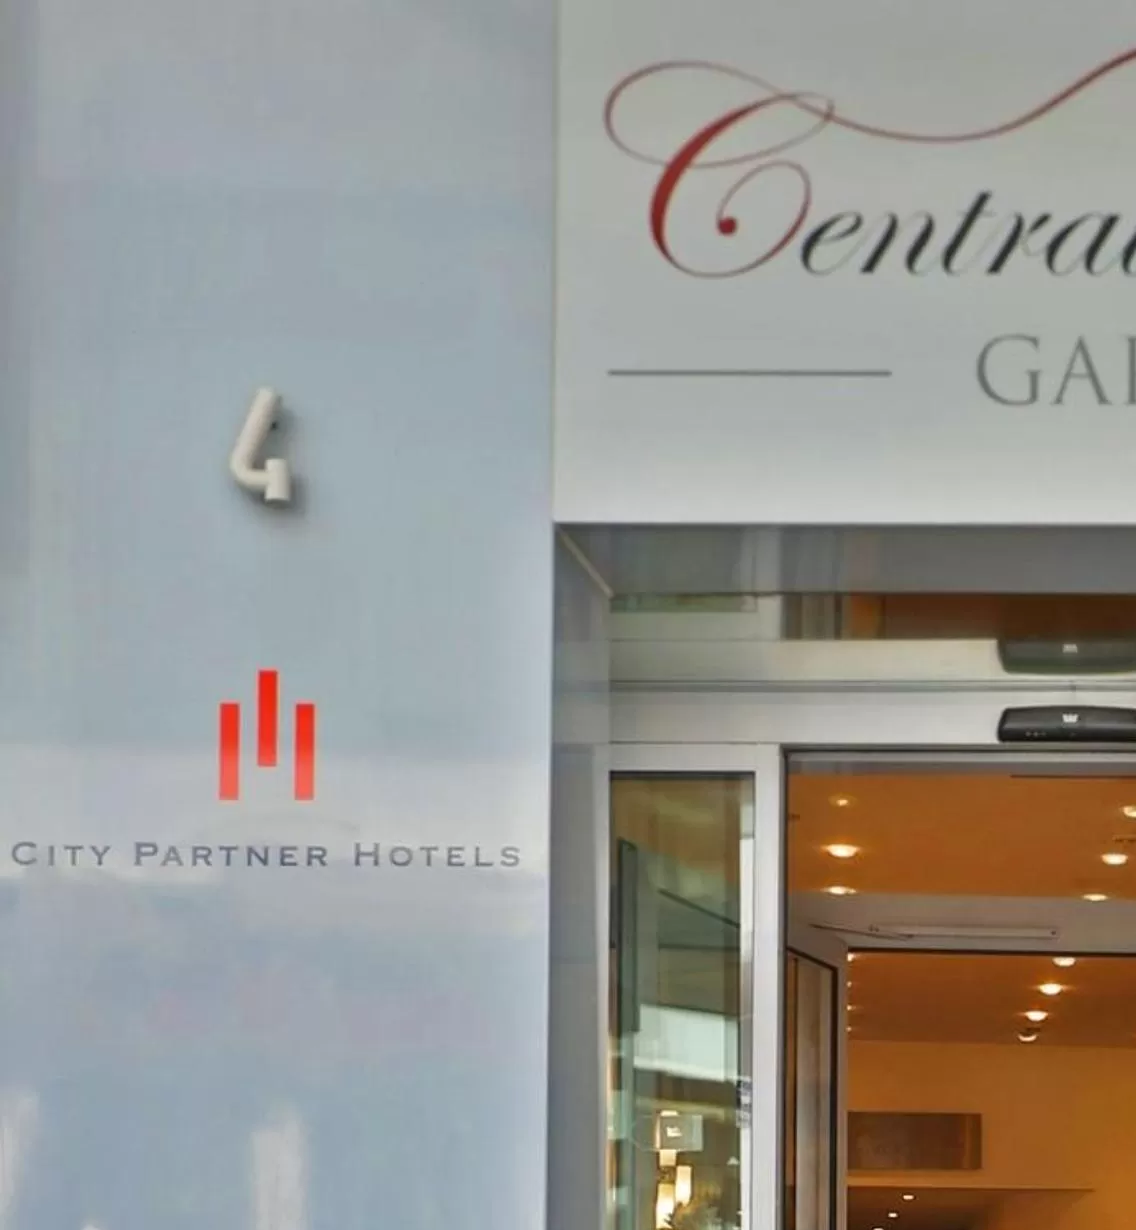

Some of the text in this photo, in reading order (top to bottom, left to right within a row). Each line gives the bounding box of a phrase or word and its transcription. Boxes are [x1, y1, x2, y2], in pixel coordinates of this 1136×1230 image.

[230, 387, 291, 501] 4
[11, 842, 521, 867] CITY PARTNER HOTELS
